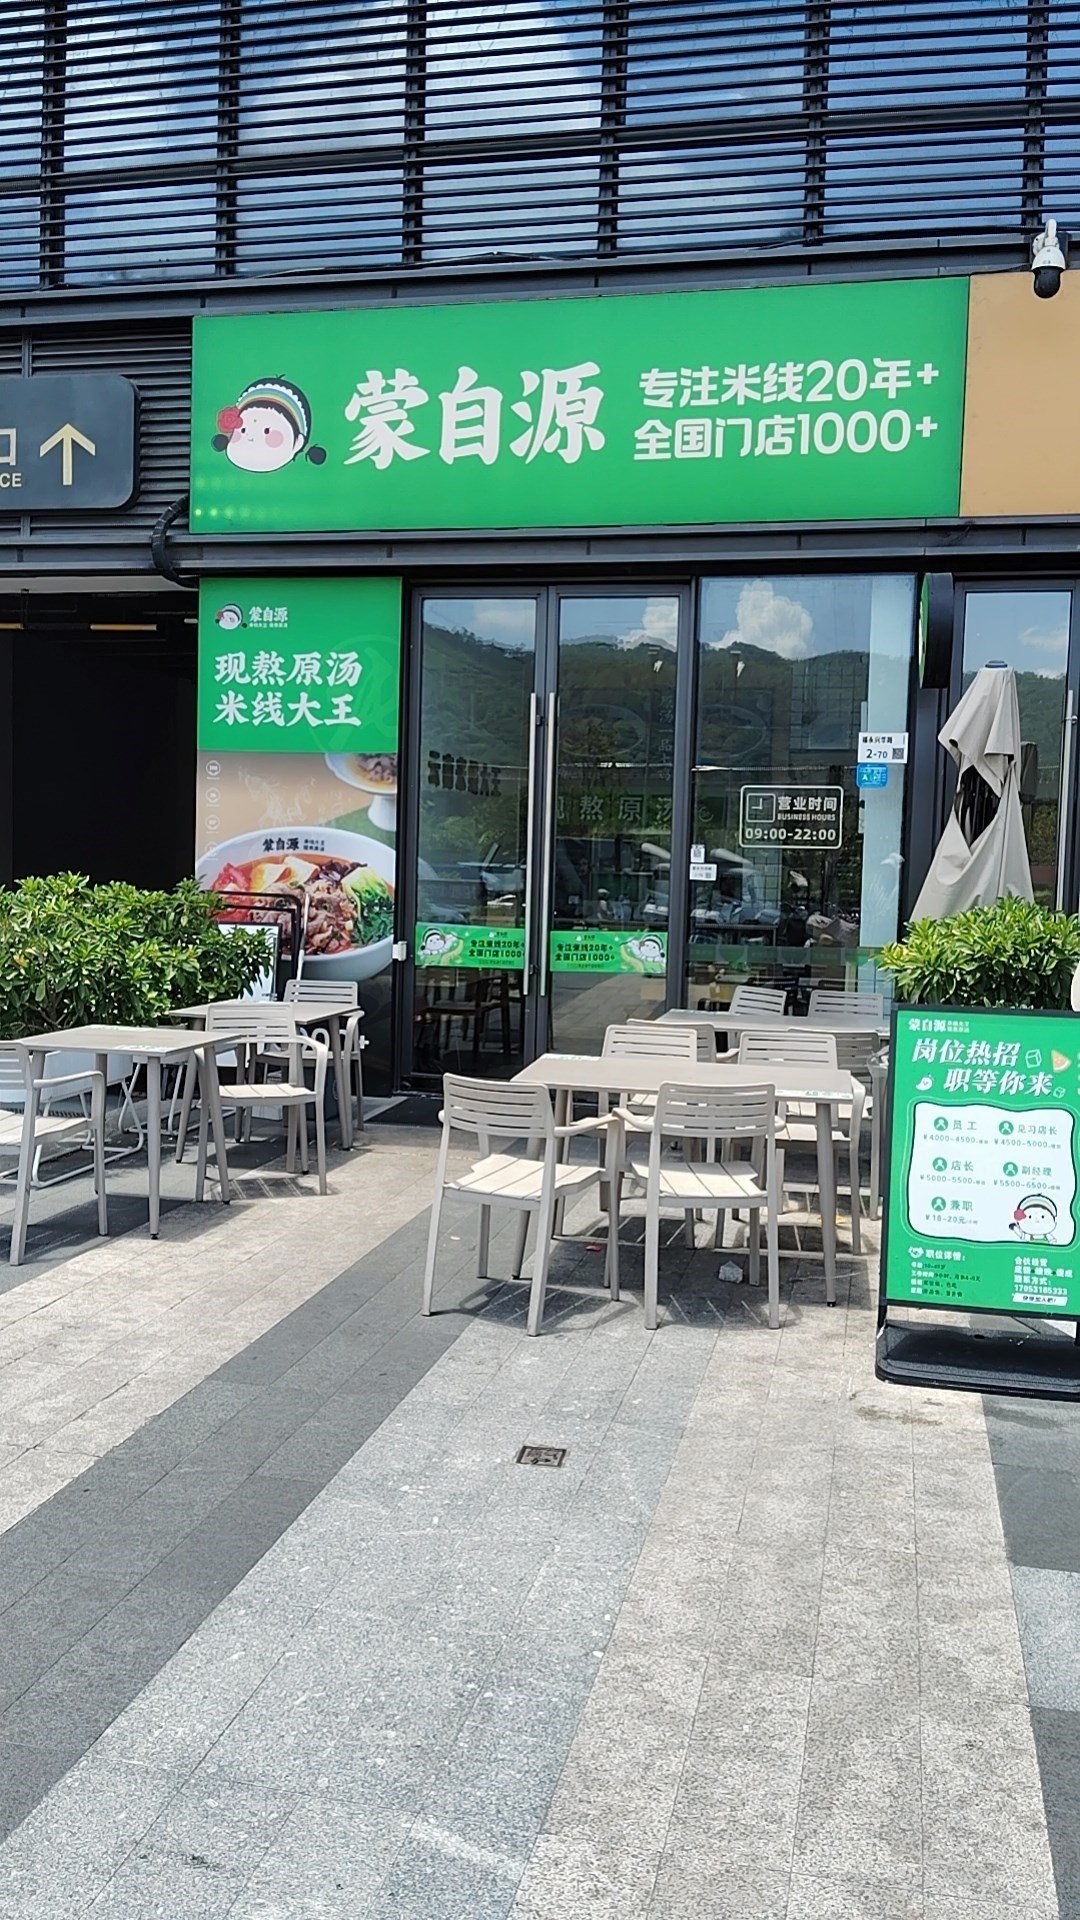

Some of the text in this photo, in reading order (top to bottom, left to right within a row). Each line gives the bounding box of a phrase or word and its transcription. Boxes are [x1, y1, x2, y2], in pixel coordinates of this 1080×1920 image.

[639, 357, 939, 408] 专注米线20年+
[344, 361, 606, 470] 蒙自源
[634, 409, 939, 460] 全国门店1000+
[213, 650, 363, 688] 现熬原汤
[212, 689, 362, 727] 米线大王
[866, 748, 888, 759] 2-70
[777, 796, 837, 811] 营业时间
[778, 813, 836, 821] BUSINESS HOURS
[745, 827, 836, 841] 09:00-22:00
[911, 1037, 1021, 1068] 岗位热招
[943, 1068, 1054, 1097] 职等你来
[953, 1120, 977, 1130] 员工
[951, 1160, 974, 1171] 店长
[1021, 1165, 1052, 1176] 副经理
[950, 1199, 973, 1211] 兼职
